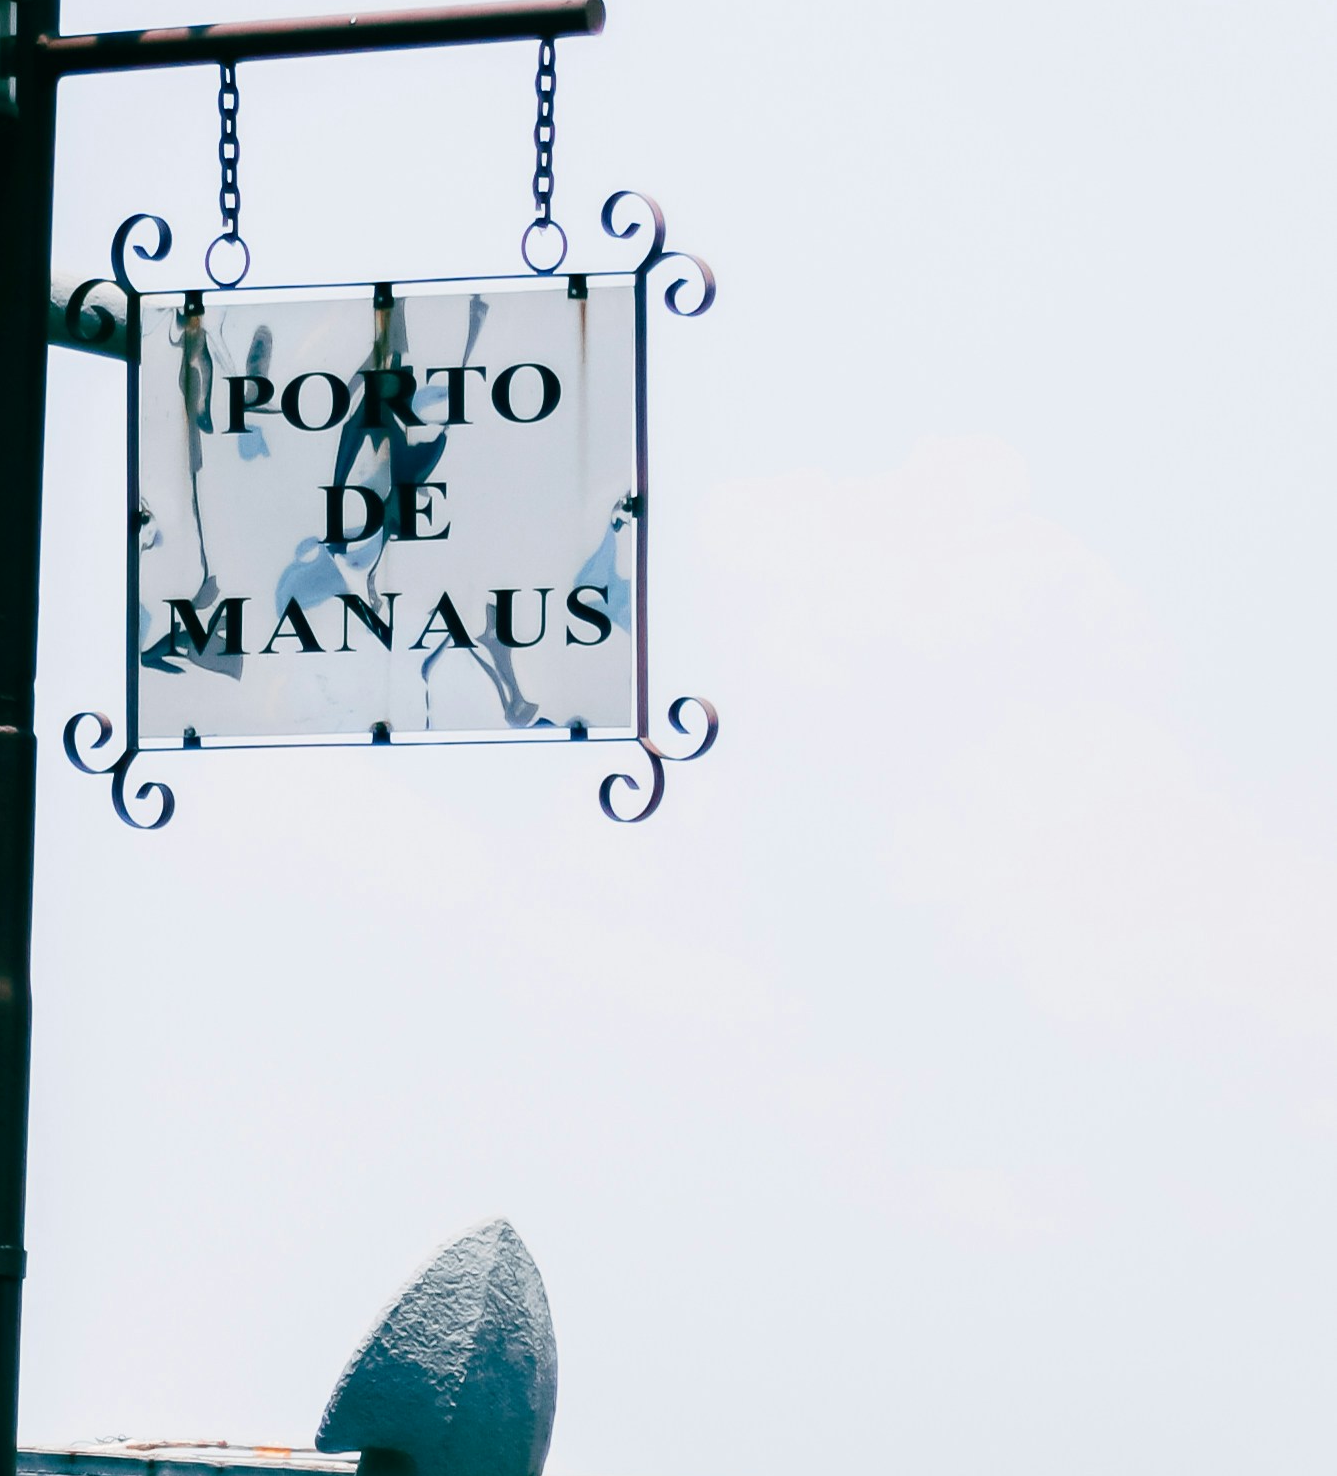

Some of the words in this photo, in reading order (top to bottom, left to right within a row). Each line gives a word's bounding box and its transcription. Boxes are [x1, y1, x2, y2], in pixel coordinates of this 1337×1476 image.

[221, 362, 562, 434] PORTO
[317, 481, 452, 545] DE
[162, 584, 613, 657] MANAUS
